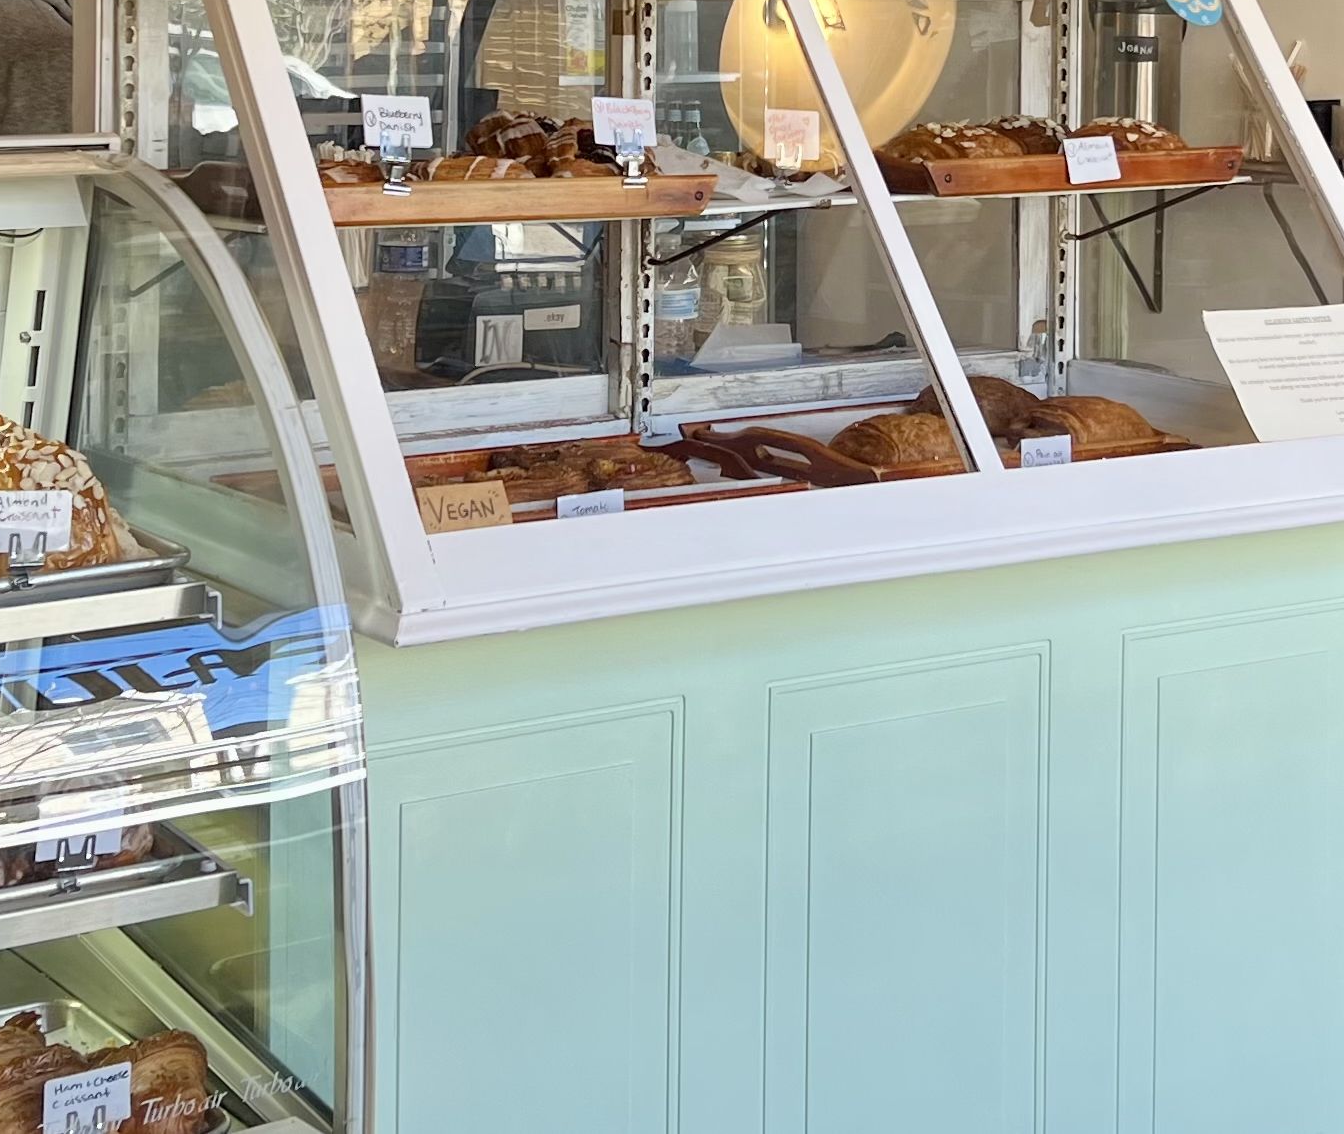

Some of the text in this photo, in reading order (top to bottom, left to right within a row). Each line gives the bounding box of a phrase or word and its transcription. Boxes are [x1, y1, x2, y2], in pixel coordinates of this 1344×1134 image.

[378, 107, 423, 126] Blueberry
[379, 121, 416, 133] Danish
[427, 495, 496, 525] VEGAN
[54, 1082, 83, 1096] Ham
[94, 1069, 129, 1086] Cheese
[240, 1071, 294, 1104] Turbo
[139, 1093, 196, 1127] Turbo
[198, 1090, 229, 1111] air
